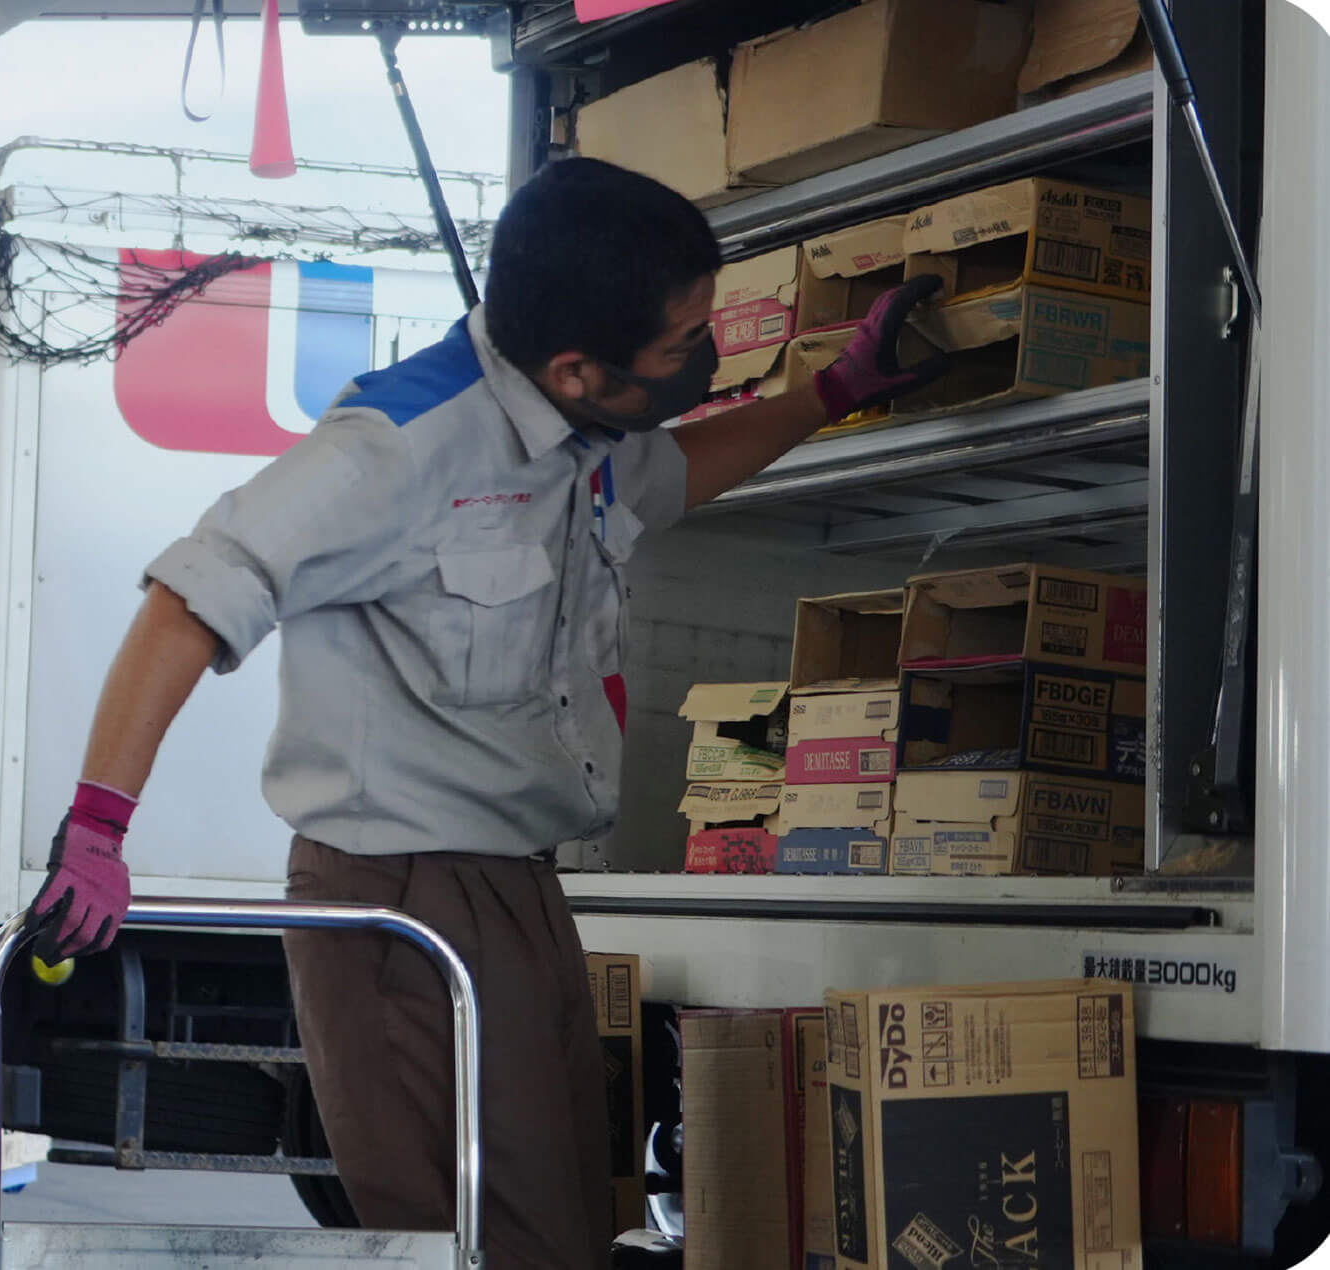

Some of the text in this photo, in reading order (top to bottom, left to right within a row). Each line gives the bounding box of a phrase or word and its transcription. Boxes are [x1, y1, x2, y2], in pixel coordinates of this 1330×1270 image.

[1036, 680, 1106, 707] FBDGE
[803, 750, 852, 771] DEMITASSE
[1034, 789, 1106, 816] FBAVN
[886, 1003, 912, 1089] DyDo
[1000, 1151, 1040, 1270] ACK
[907, 1227, 943, 1262] Blend
[967, 1214, 1000, 1268] The
